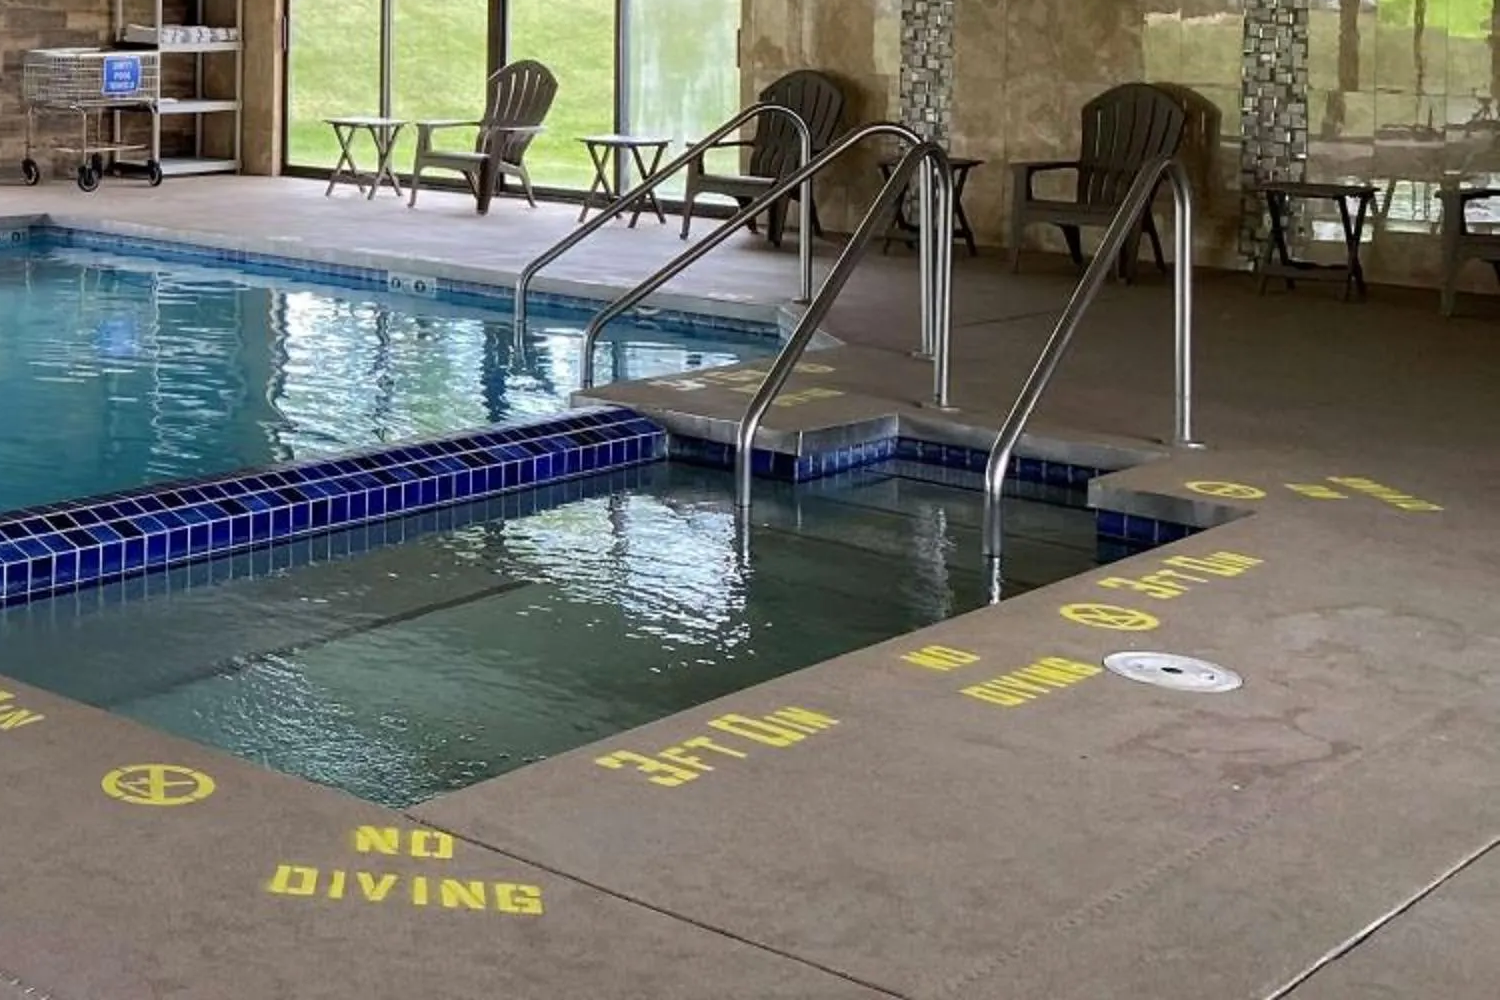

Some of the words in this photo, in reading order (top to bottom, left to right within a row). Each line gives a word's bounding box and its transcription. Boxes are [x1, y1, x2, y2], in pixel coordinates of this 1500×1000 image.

[900, 645, 982, 672] NO
[957, 656, 1104, 707] DIVING
[355, 825, 454, 860] NO
[268, 864, 544, 916] DIVING
